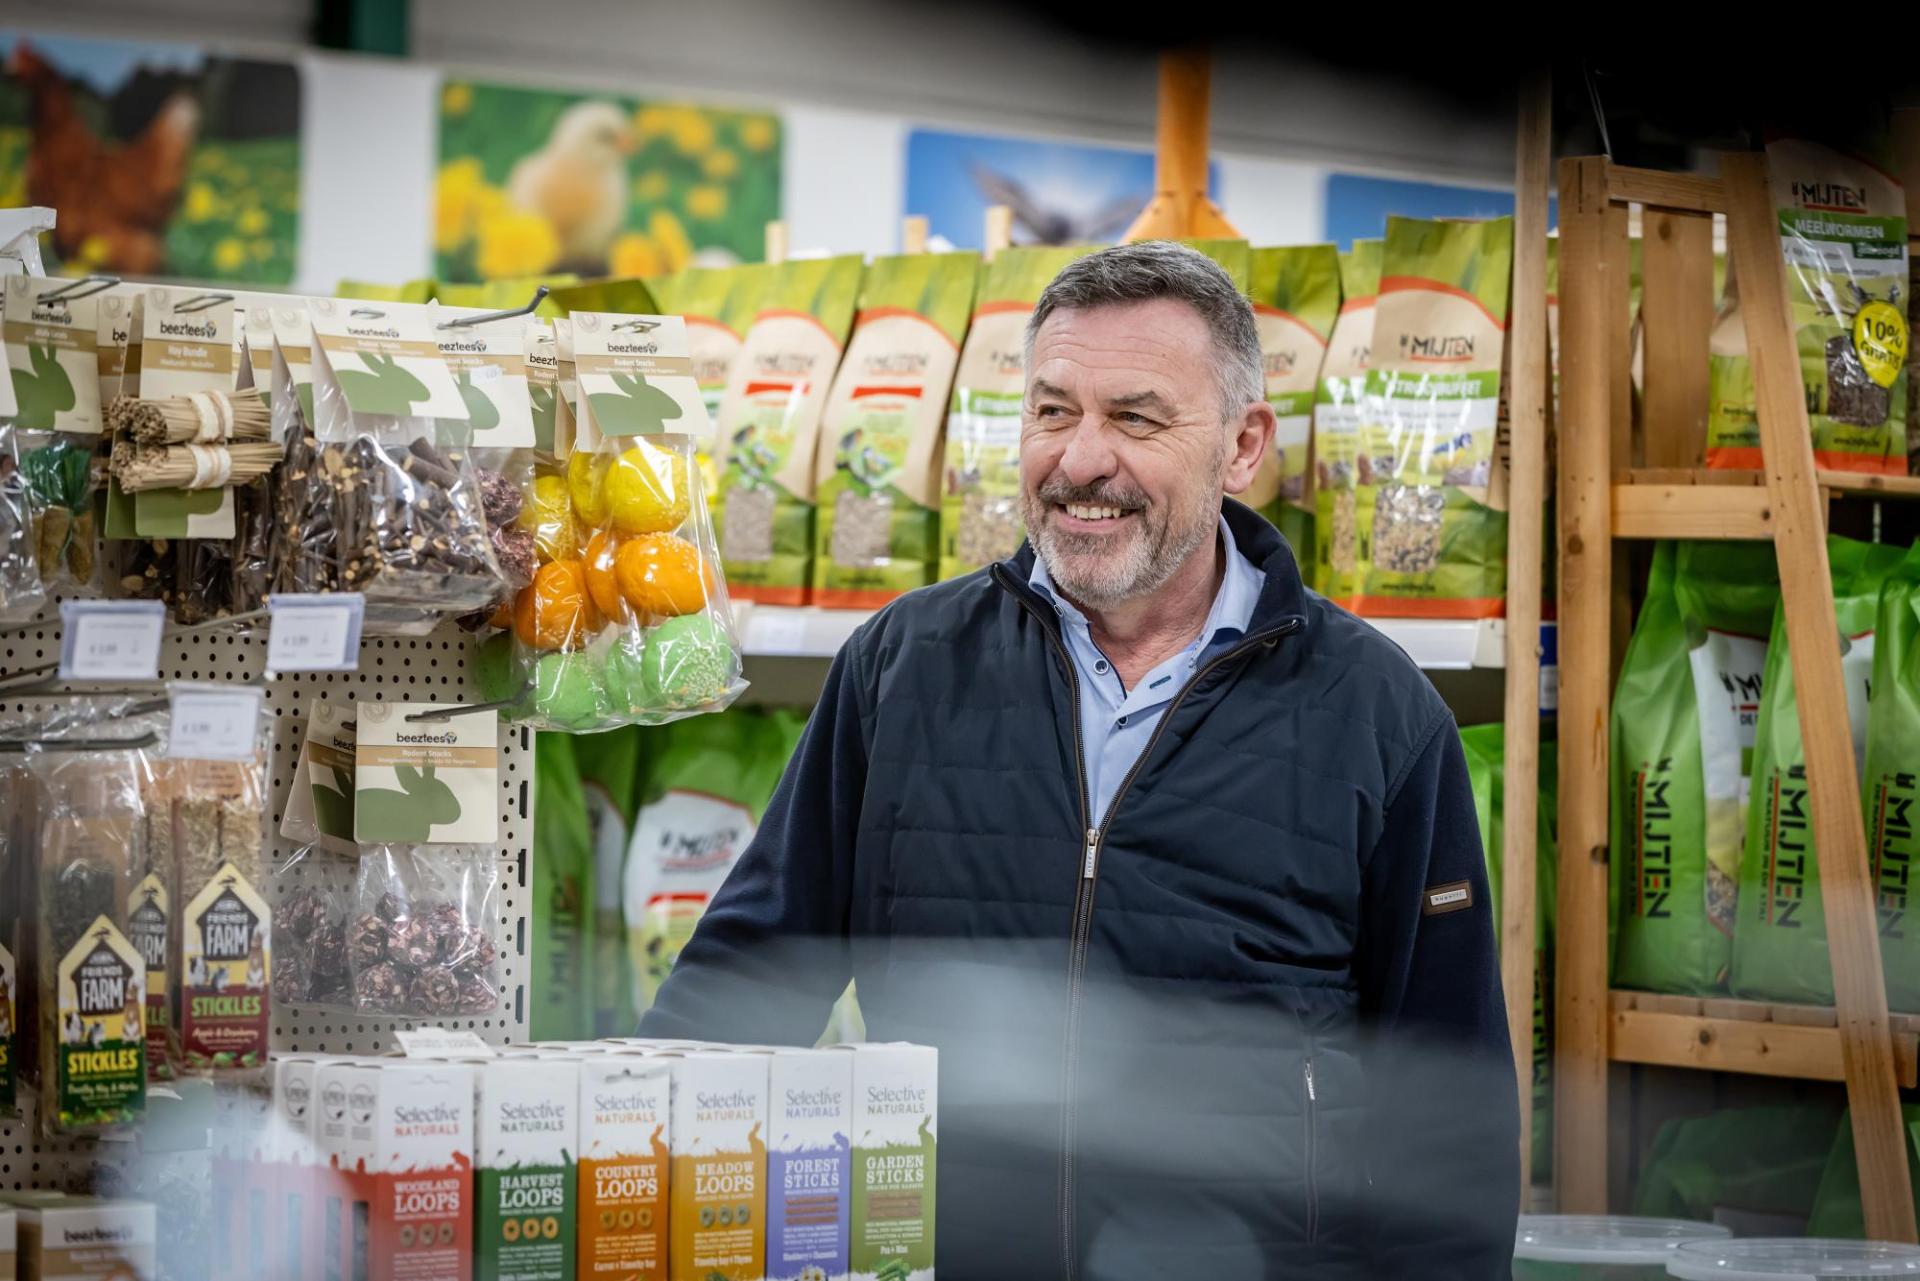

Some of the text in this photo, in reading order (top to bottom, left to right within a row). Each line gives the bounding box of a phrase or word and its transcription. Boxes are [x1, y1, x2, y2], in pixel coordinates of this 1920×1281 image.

[1802, 183, 1866, 206] MIJTEN
[1795, 219, 1884, 239] MEELWORMEN
[160, 320, 206, 337] beeztees
[1864, 317, 1903, 349] 10%
[438, 341, 476, 352] eeztees
[608, 343, 647, 353] beeztees
[1411, 335, 1474, 357] MIJTEN
[1860, 341, 1900, 370] GRATIS
[396, 732, 446, 743] beeztees
[1763, 798, 1773, 852] NATUUR
[1644, 781, 1671, 918] MIJTEN
[1775, 787, 1807, 928] MIJTEN
[1879, 797, 1914, 940] MIJTEN
[206, 925, 248, 957] FARM
[81, 978, 124, 1012] FARM
[191, 996, 261, 1017] STICKLES
[68, 1049, 138, 1073] STICKLES
[594, 1091, 656, 1111] Selective
[696, 1089, 756, 1110] Selective
[785, 1086, 841, 1106] Selective
[867, 1084, 926, 1103] Selective
[394, 1102, 460, 1124] Selective
[500, 1100, 565, 1120] Selective
[594, 1111, 655, 1125] NATURALS
[696, 1109, 755, 1122] NATURALS
[785, 1106, 840, 1119] NATURALS
[867, 1103, 925, 1116] NATURALS
[394, 1123, 459, 1136] NATURALS
[500, 1119, 564, 1133] NATURALS
[595, 1164, 657, 1180] COUNTRY
[695, 1161, 754, 1176] MEADOW
[785, 1158, 839, 1174] FOREST
[866, 1155, 924, 1170] GARDEN
[394, 1179, 460, 1193] WOODLAND
[500, 1173, 563, 1189] HARVEST
[695, 1175, 754, 1194] LOOPS
[784, 1172, 840, 1188] STICKS
[866, 1168, 924, 1184] STICKS
[500, 1187, 563, 1208] LOOPS
[595, 1178, 658, 1199] LOOPS
[394, 1192, 460, 1214] LOOPS
